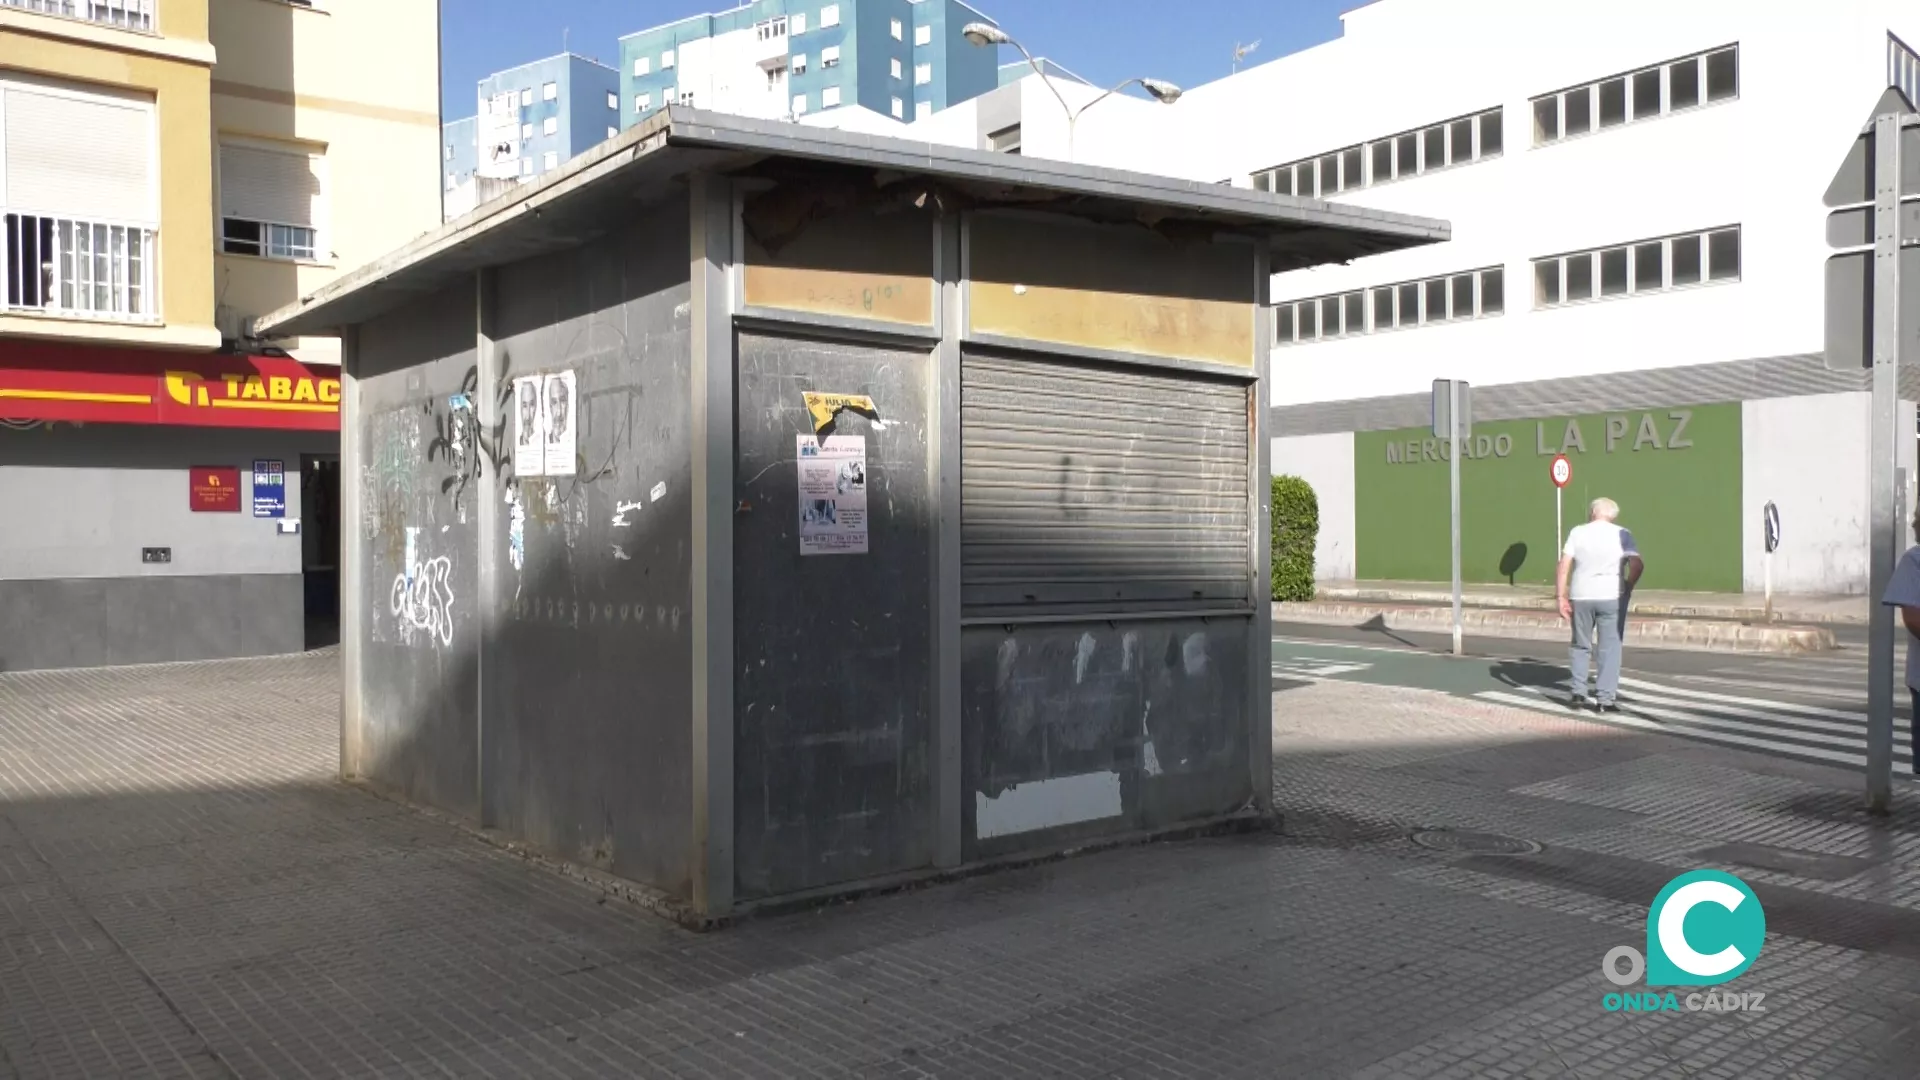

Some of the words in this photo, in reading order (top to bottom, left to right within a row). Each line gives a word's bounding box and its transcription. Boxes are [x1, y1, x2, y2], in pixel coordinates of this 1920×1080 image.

[1386, 434, 1512, 464] MERCADO
[1536, 419, 1586, 456] LA
[1605, 410, 1694, 453] PAZ
[1556, 465, 1567, 476] 30
